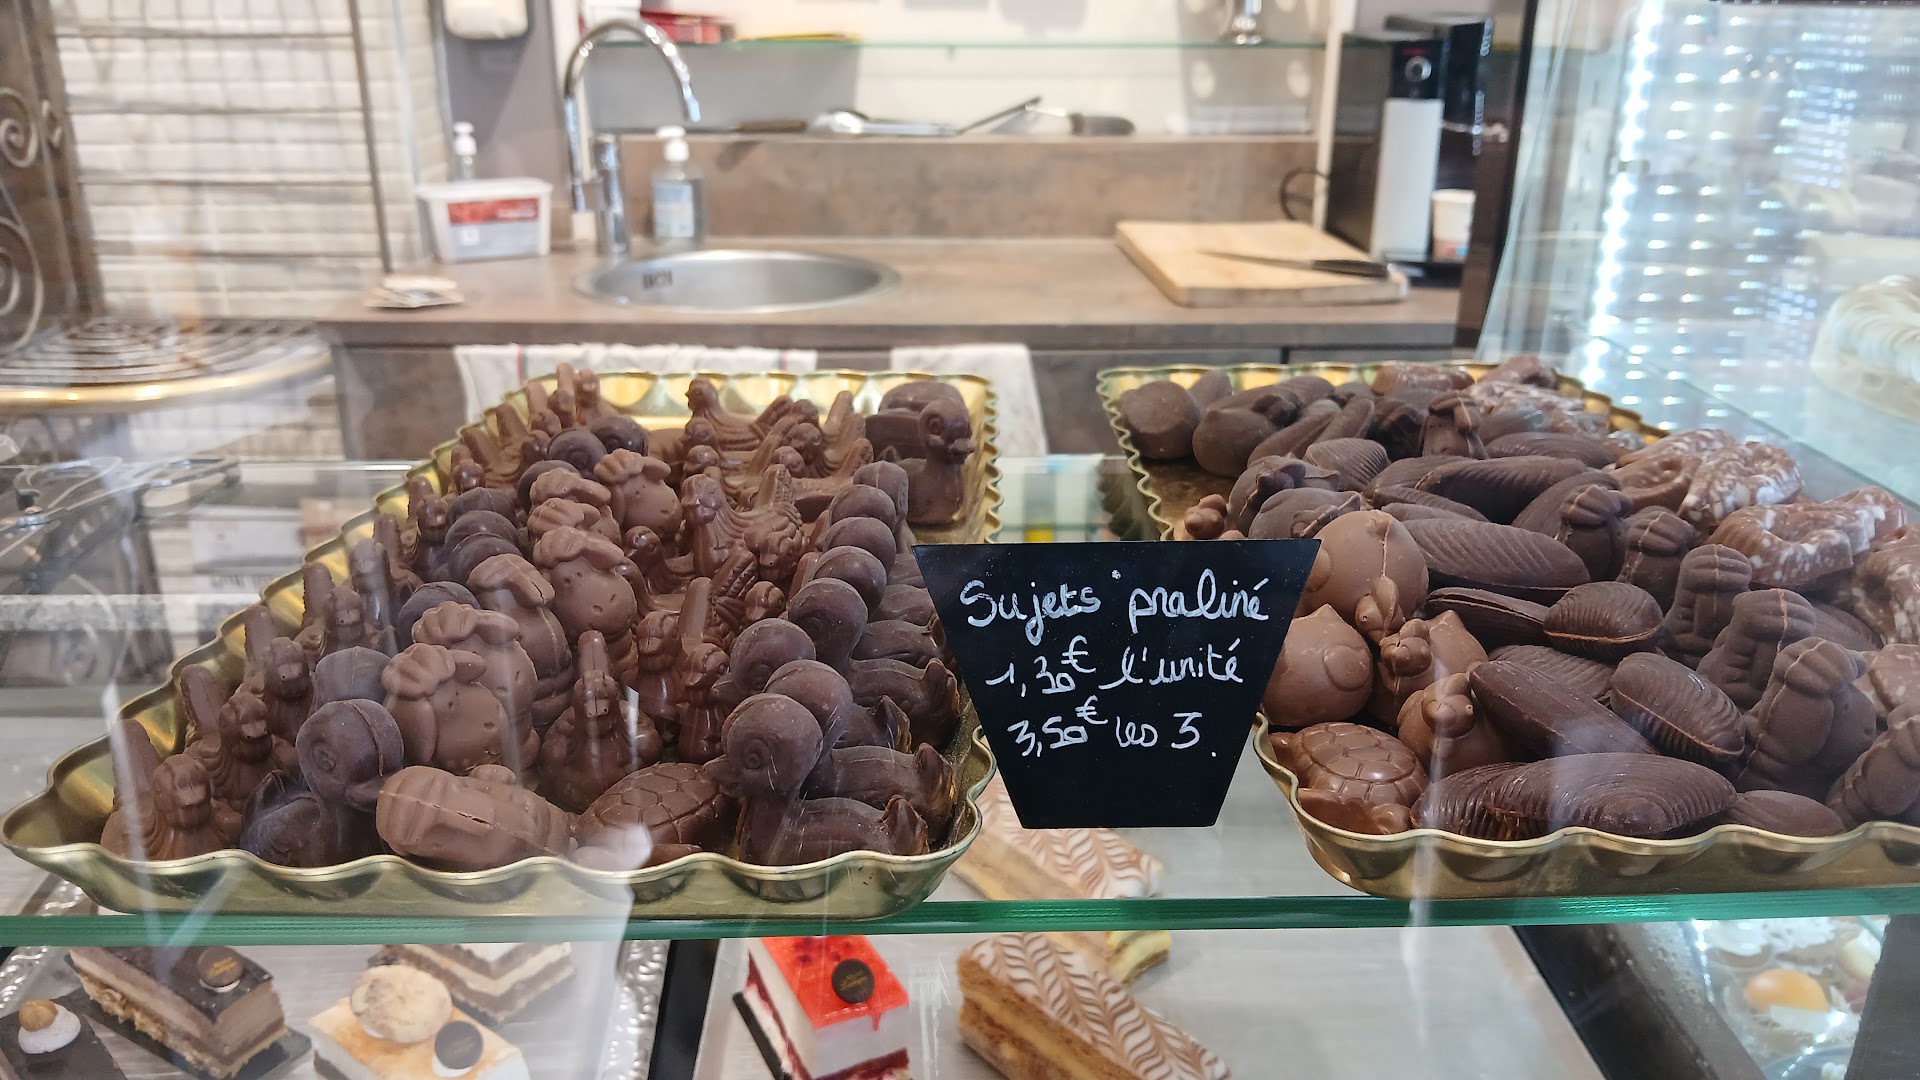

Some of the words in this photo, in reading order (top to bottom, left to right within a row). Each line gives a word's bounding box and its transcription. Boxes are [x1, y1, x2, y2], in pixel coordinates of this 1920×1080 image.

[959, 580, 1101, 646] Sujets
[1128, 568, 1270, 634] praliné
[1098, 638, 1244, 690] l'unité
[1007, 695, 1109, 758] 3,50€
[1115, 716, 1159, 749] les
